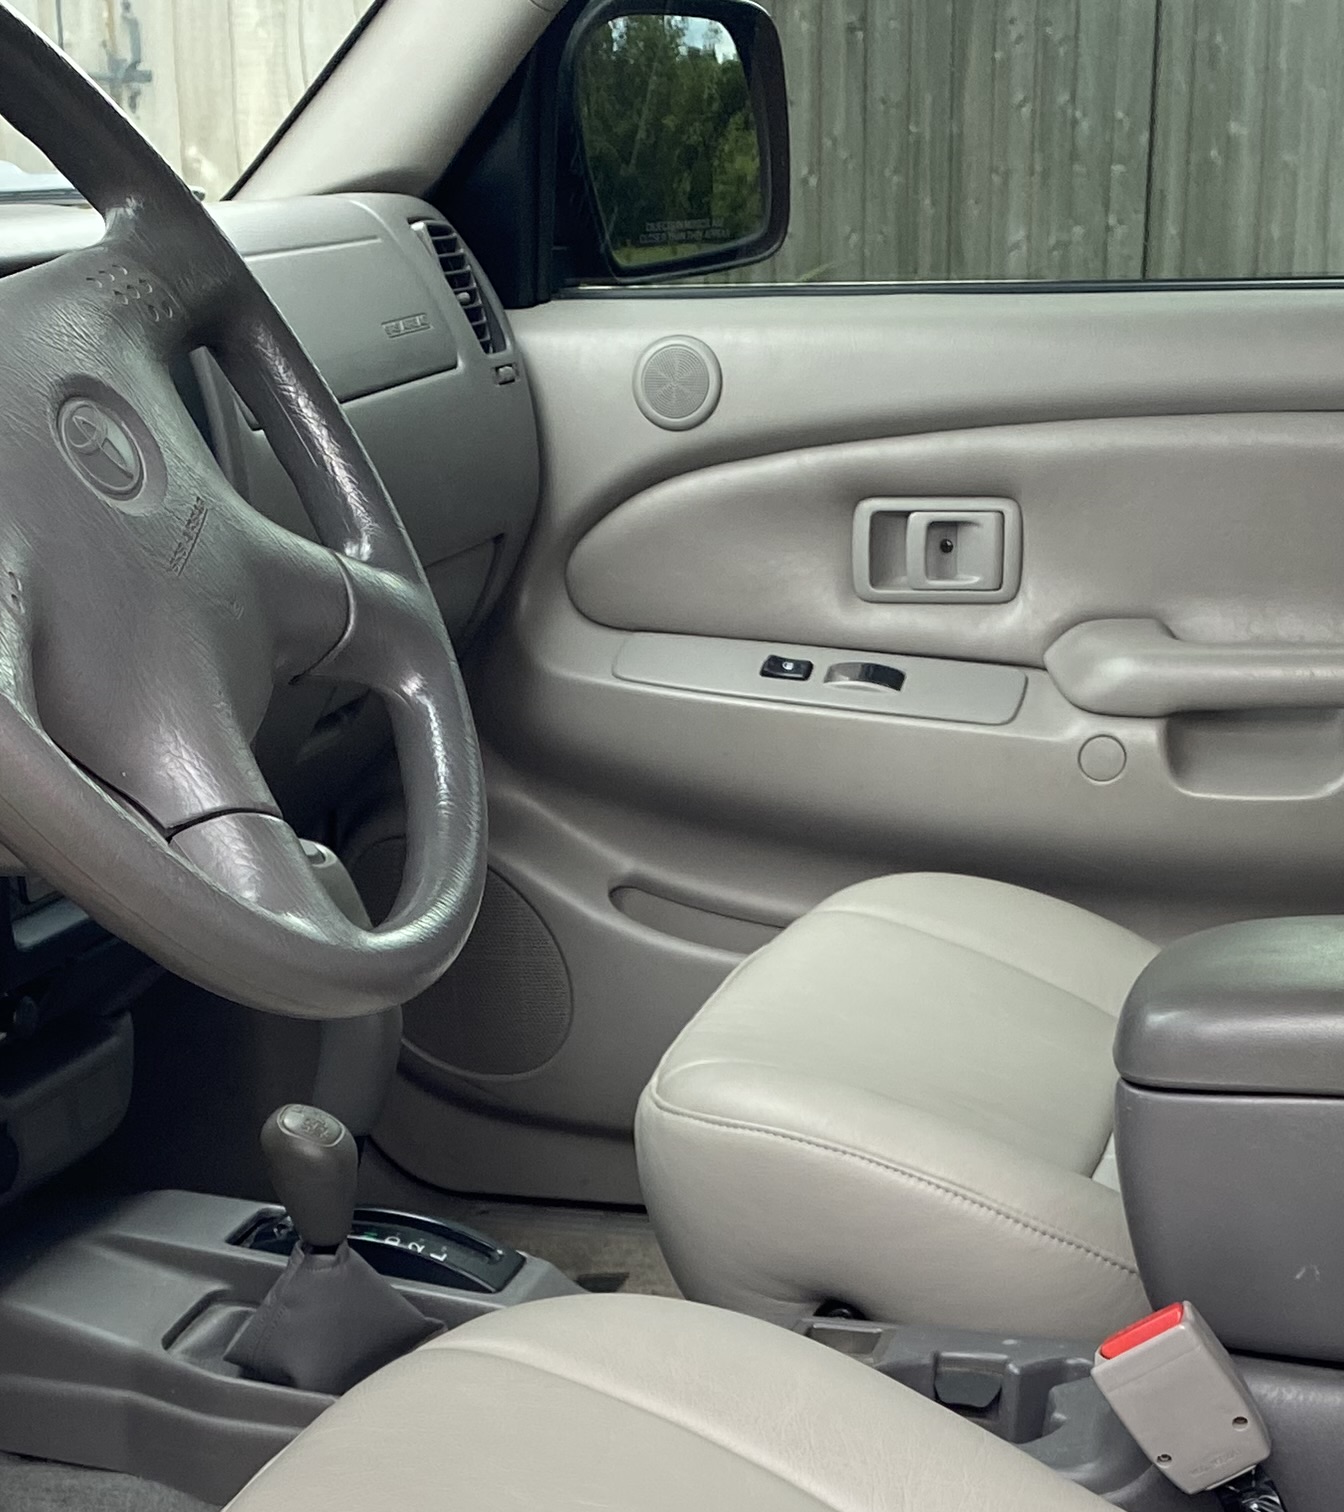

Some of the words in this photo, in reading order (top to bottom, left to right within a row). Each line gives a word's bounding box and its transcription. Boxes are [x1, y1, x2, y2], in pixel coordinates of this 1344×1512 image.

[385, 1236, 400, 1246] D
[407, 1242, 426, 1254] 2
[429, 1253, 447, 1262] L
